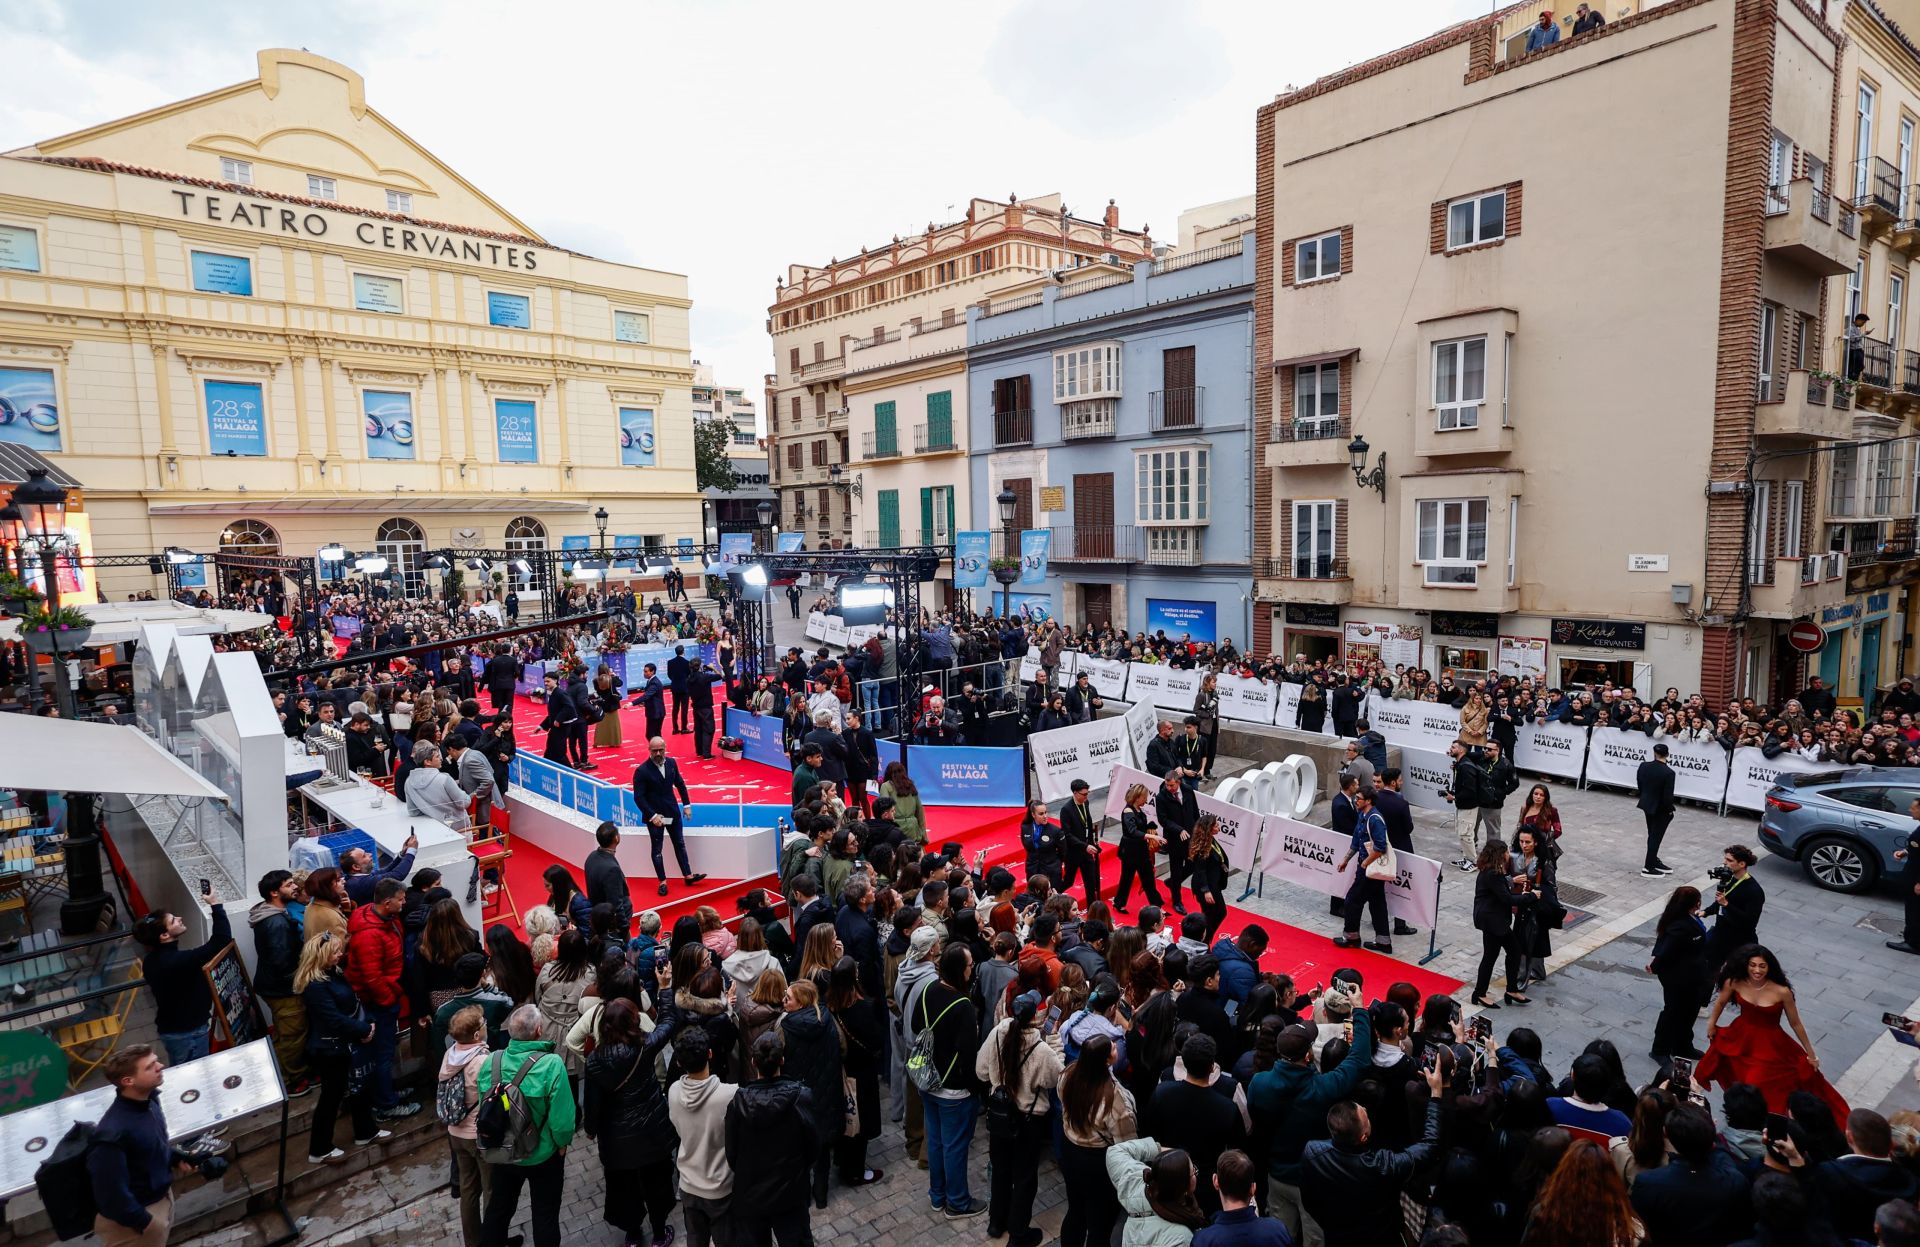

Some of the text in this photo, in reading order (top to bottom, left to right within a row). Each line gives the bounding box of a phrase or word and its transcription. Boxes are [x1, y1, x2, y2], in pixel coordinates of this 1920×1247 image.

[172, 190, 536, 270] TEATRO CERVANTES
[212, 400, 239, 418] 28
[500, 416, 520, 430] 28
[1576, 624, 1616, 640] Kebab
[1594, 640, 1637, 648] CERVANTES
[1535, 734, 1561, 742] FESTIVAL
[1089, 740, 1112, 749] FESTIVAL
[1605, 744, 1636, 755] FESTIVAL
[1045, 750, 1072, 759] FESTIVAL
[1669, 754, 1700, 764] ESTIVAL
[1410, 766, 1439, 776] FESTIVAL
[1749, 766, 1782, 776] FESTIVA
[1229, 820, 1240, 829] DE
[1284, 835, 1335, 855] FESTIVAL DE
[1402, 869, 1413, 879] DE
[0, 1054, 51, 1078] ERÍA
